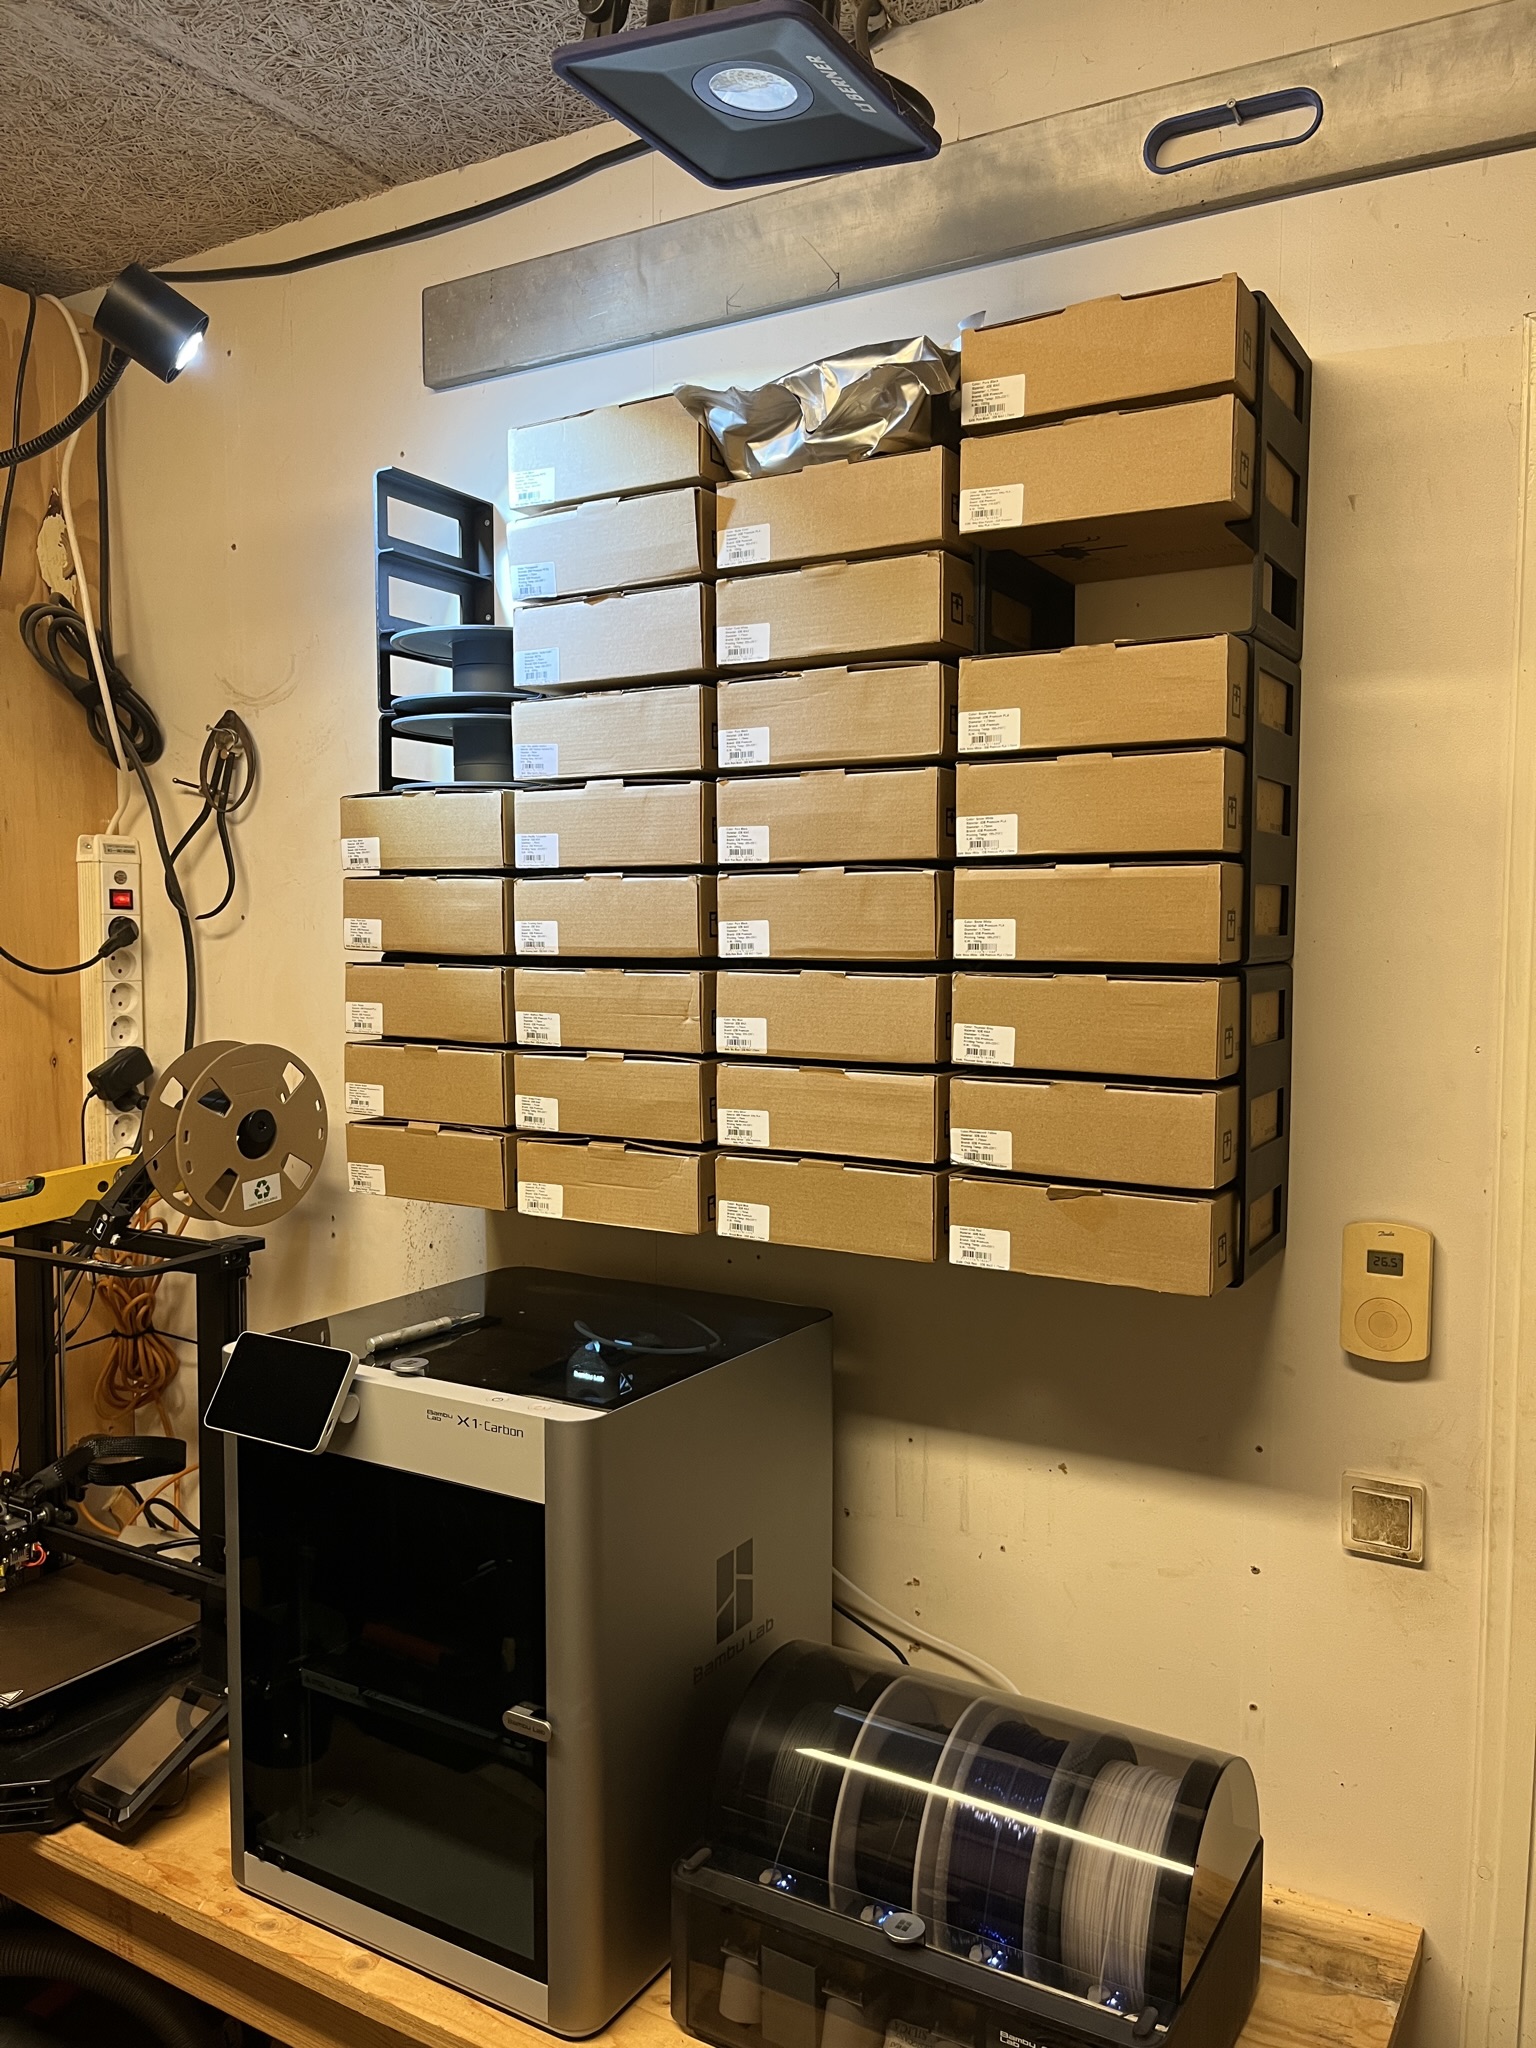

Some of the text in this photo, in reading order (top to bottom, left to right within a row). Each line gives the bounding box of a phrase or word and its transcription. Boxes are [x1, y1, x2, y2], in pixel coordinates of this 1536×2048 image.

[805, 55, 865, 102] BERNER
[1373, 1256, 1398, 1268] 26.5
[426, 1409, 453, 1419] Bambu
[693, 1618, 774, 1685] Bambu Lab
[894, 2020, 929, 2041] SILICA
